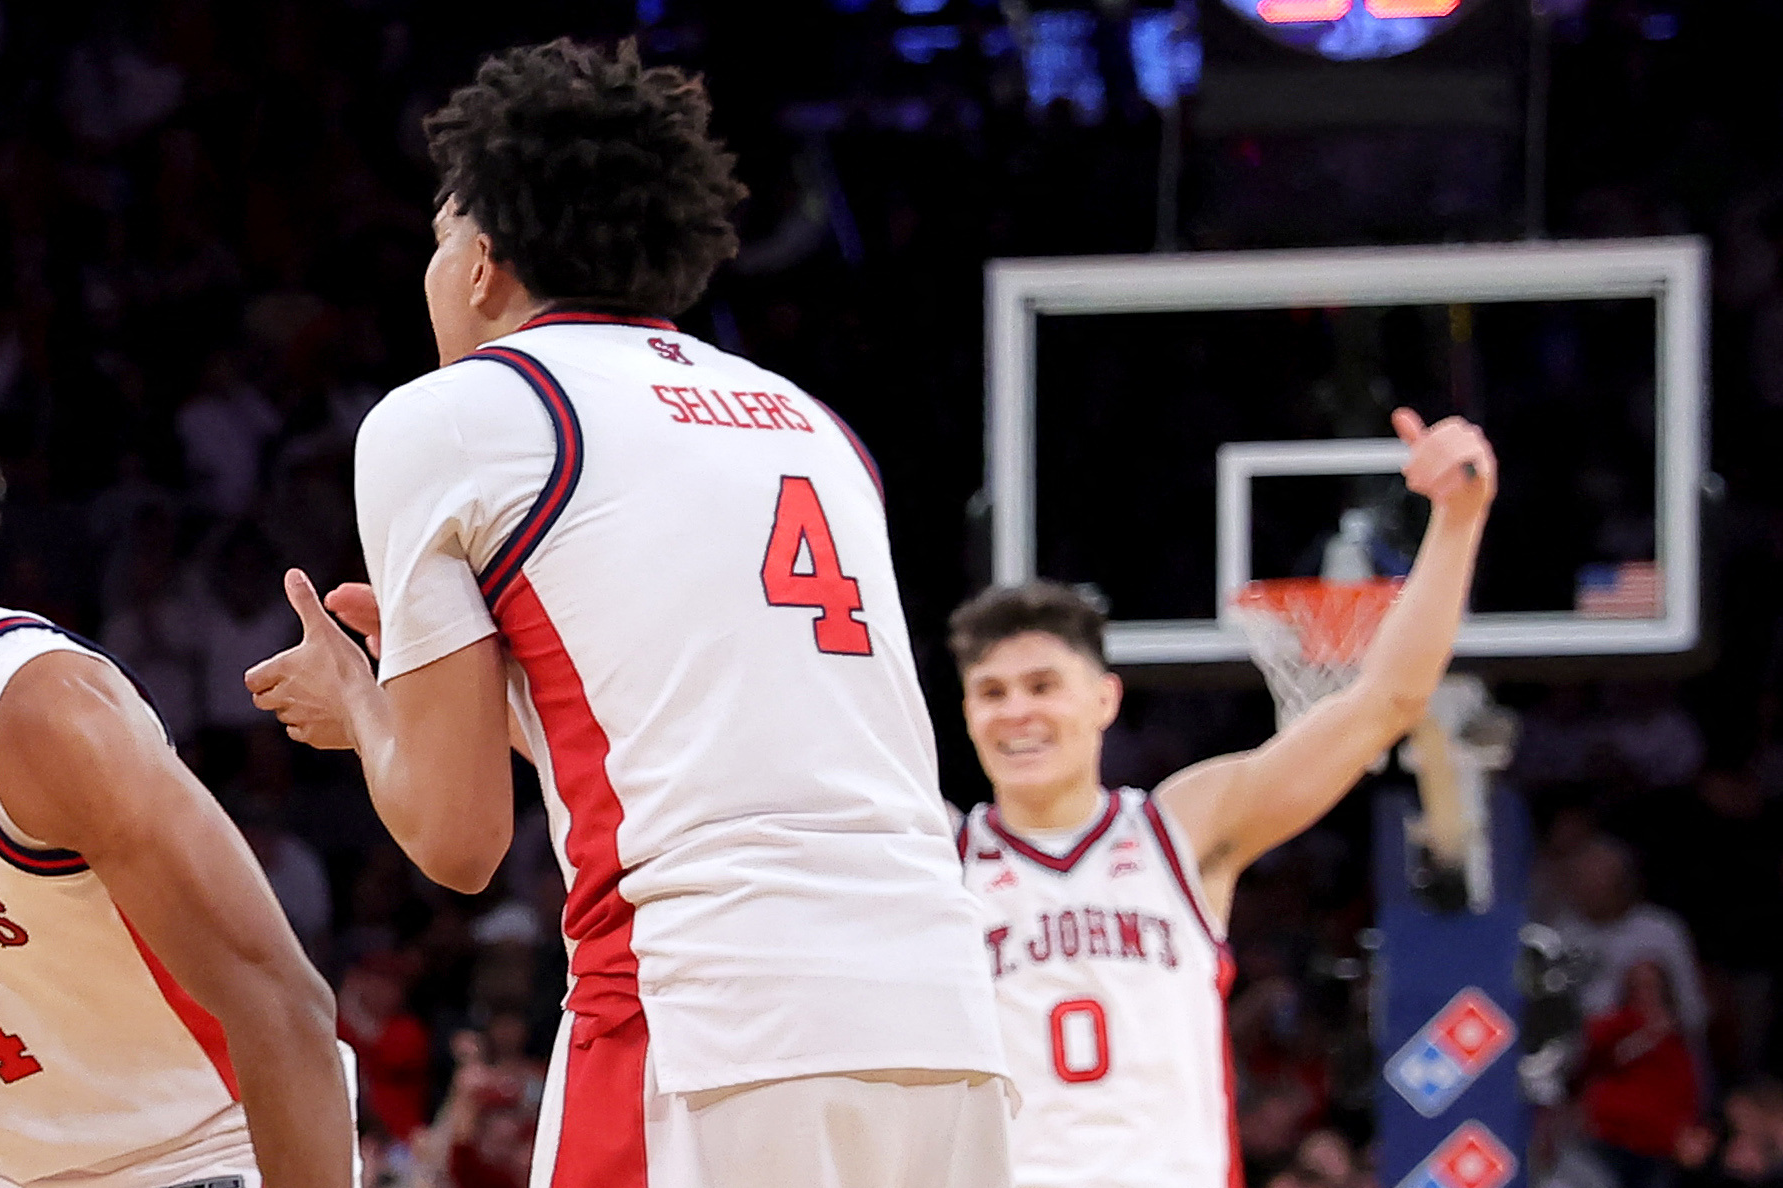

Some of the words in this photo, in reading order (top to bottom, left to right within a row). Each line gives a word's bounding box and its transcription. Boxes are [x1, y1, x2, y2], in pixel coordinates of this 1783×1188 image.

[650, 384, 816, 433] SELLERS
[759, 474, 874, 657] 4
[1048, 998, 1111, 1084] 0
